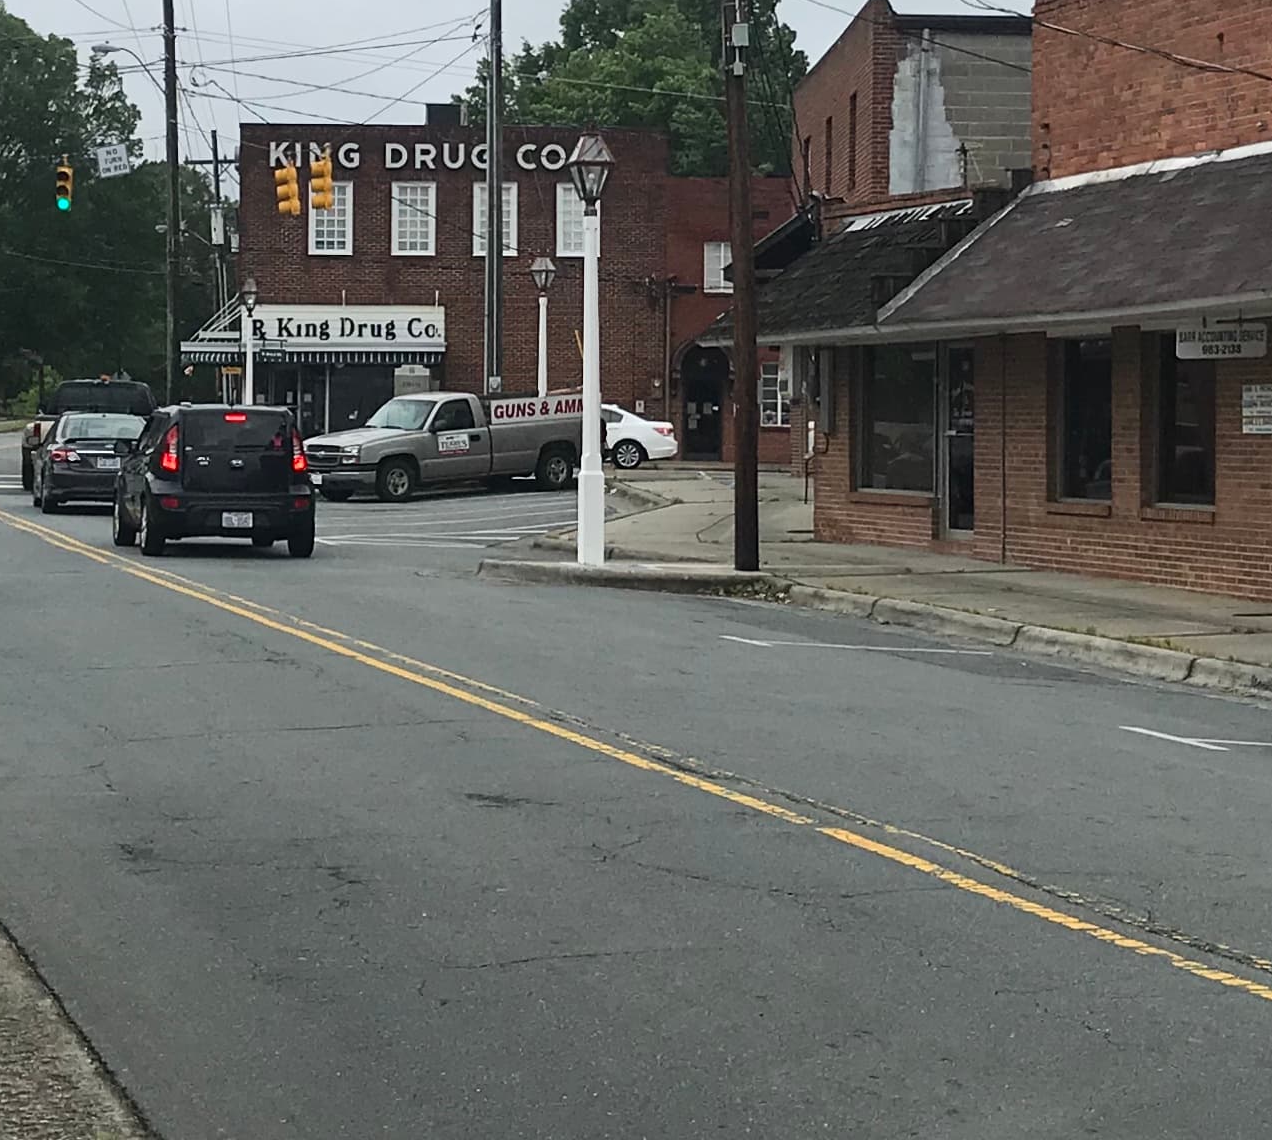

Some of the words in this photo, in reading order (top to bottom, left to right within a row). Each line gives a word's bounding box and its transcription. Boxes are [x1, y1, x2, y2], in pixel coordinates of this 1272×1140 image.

[104, 156, 122, 165] TURN
[277, 317, 330, 340] King
[340, 317, 396, 340] Drug
[493, 402, 536, 419] GUNS
[539, 401, 550, 415] &
